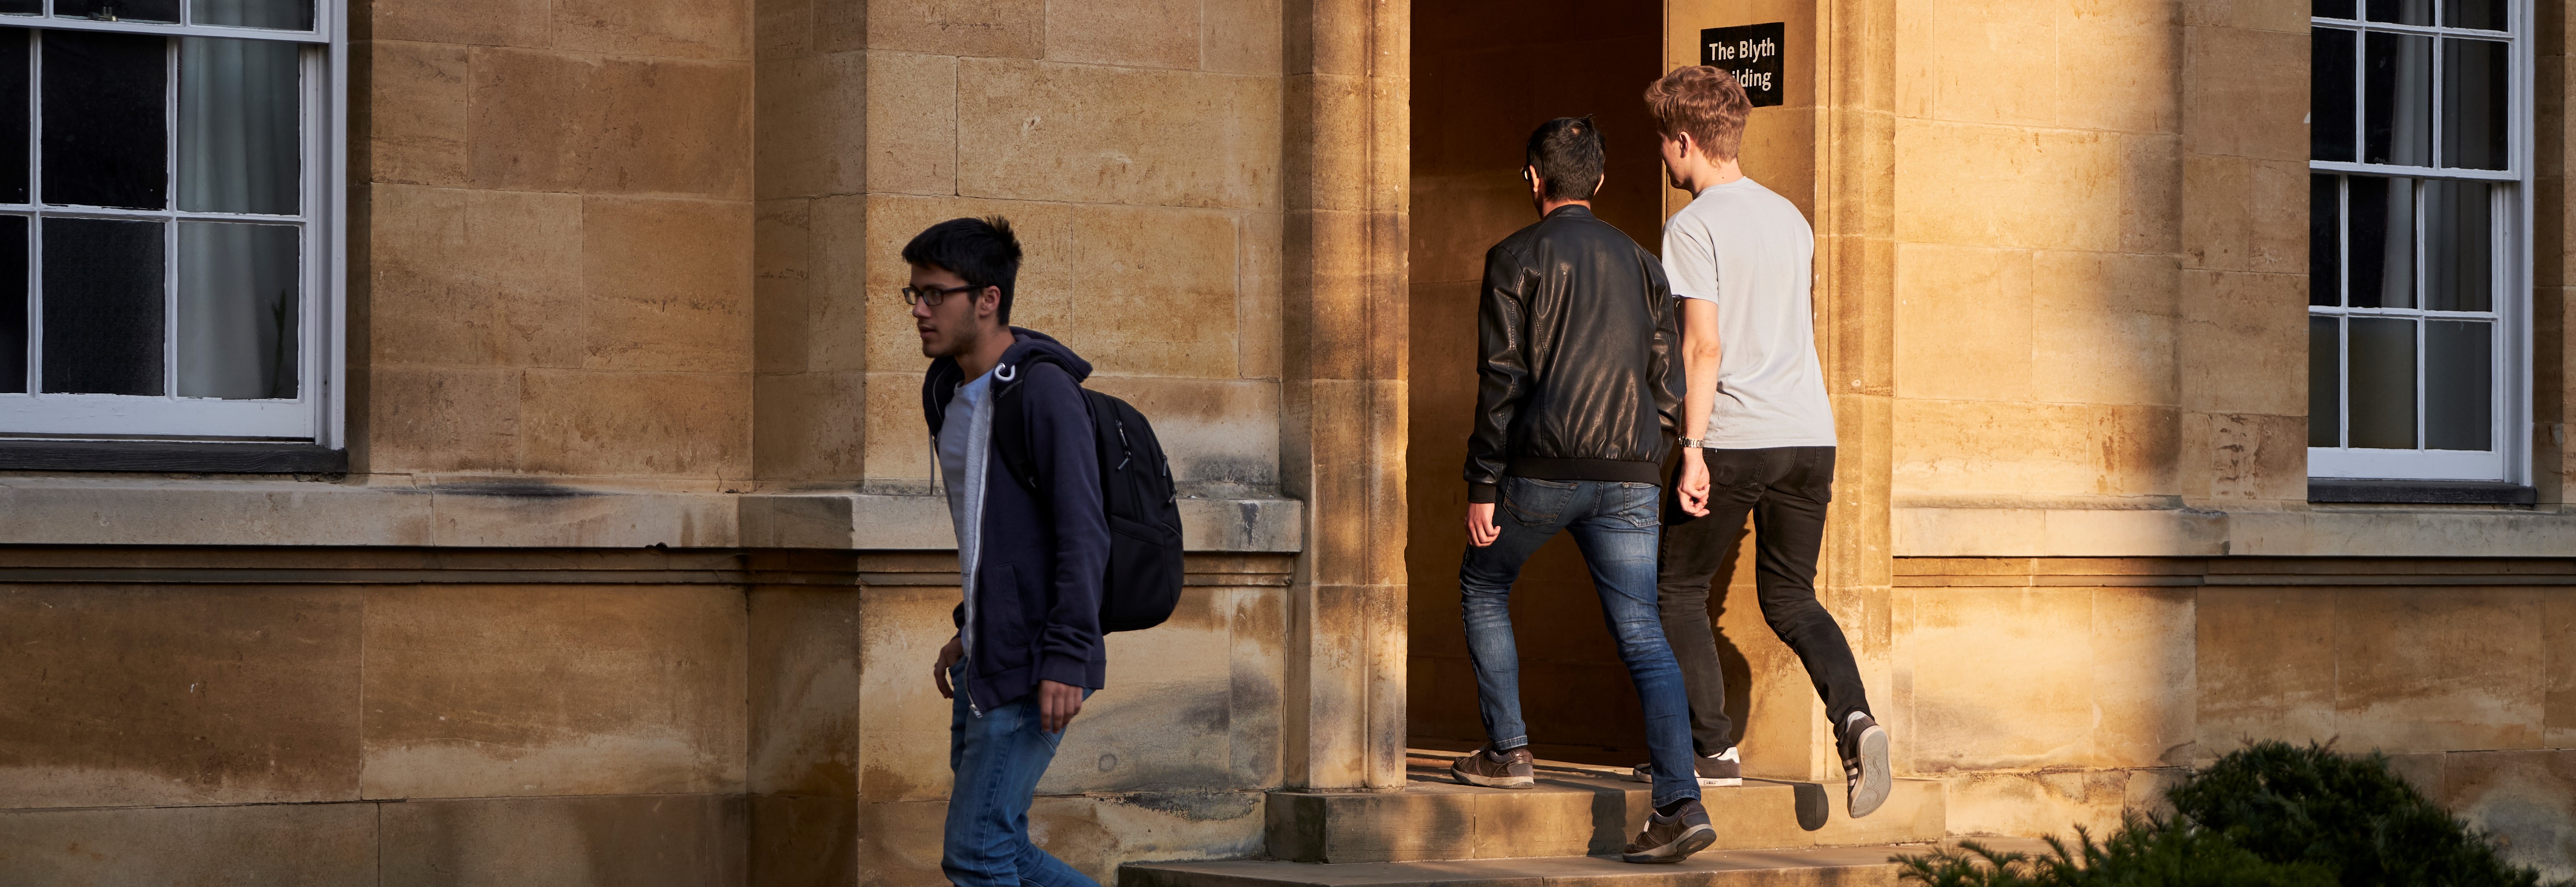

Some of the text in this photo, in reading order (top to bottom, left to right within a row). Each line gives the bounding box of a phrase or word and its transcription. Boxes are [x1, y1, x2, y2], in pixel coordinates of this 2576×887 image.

[1709, 38, 1775, 63] The Blyth
[1732, 69, 1772, 91] lding
